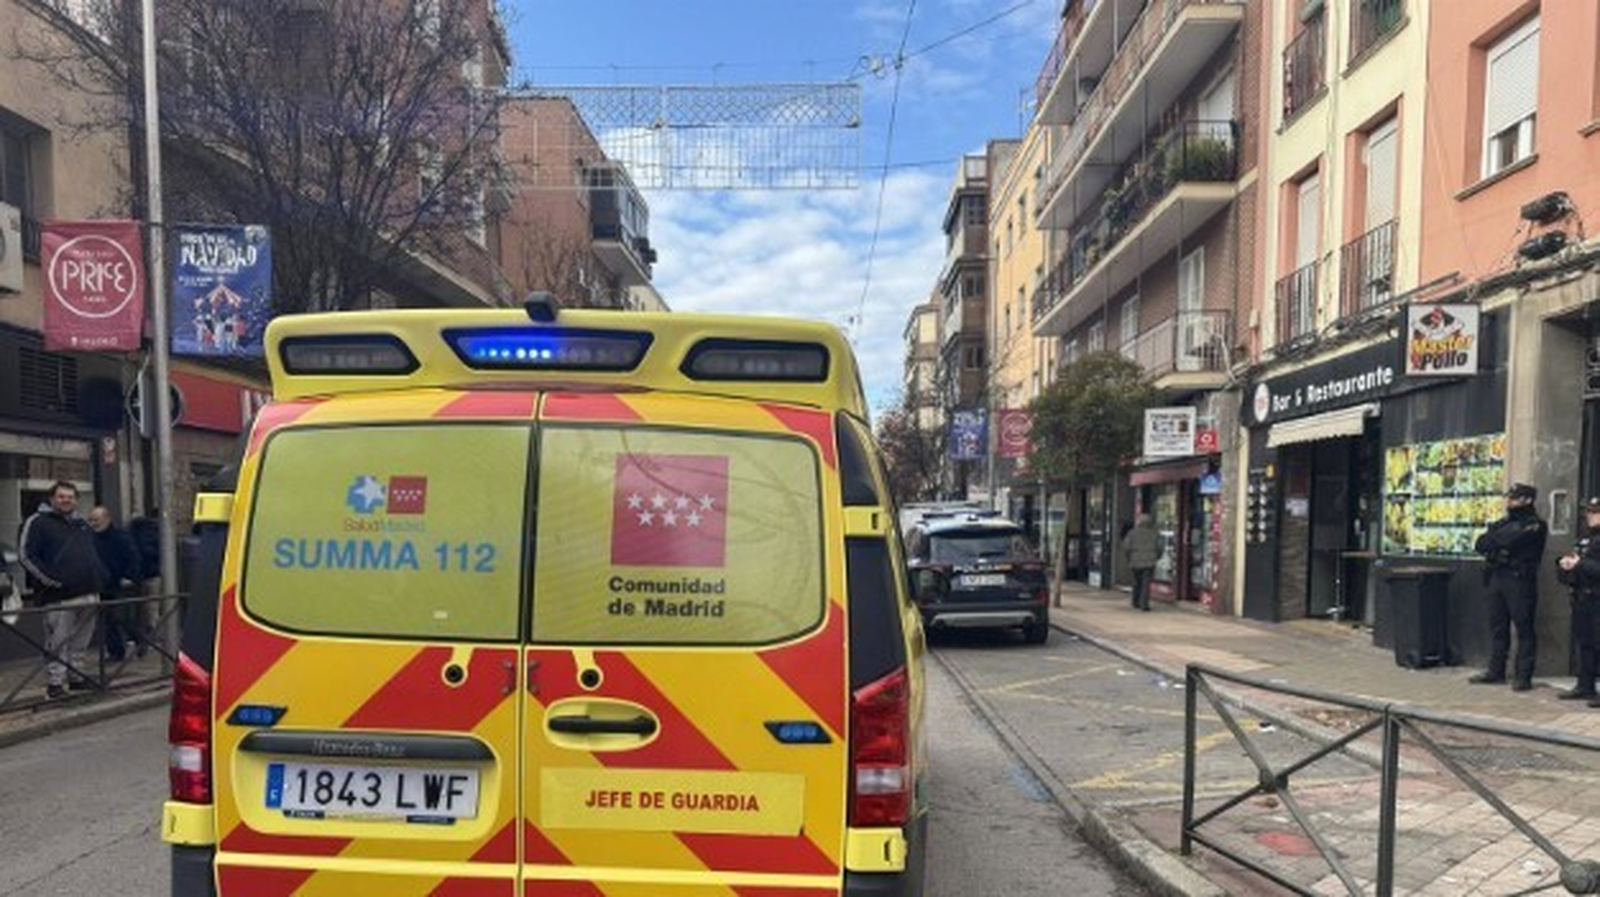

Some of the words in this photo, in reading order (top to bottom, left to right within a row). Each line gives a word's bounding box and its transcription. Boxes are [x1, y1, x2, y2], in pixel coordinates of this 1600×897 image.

[1420, 350, 1469, 371] Pollo
[1273, 394, 1292, 412] Bar
[1307, 366, 1394, 404] Restaurante
[274, 537, 420, 570] SUMMA
[434, 541, 496, 573] 112
[608, 575, 726, 594] Comunidad
[608, 598, 636, 616] de
[644, 599, 726, 617] Madrid
[296, 769, 383, 807] 1843
[395, 774, 469, 811] LWF
[585, 791, 633, 809] JEFE
[638, 792, 666, 809] DE
[671, 792, 761, 812] GUARDIA
